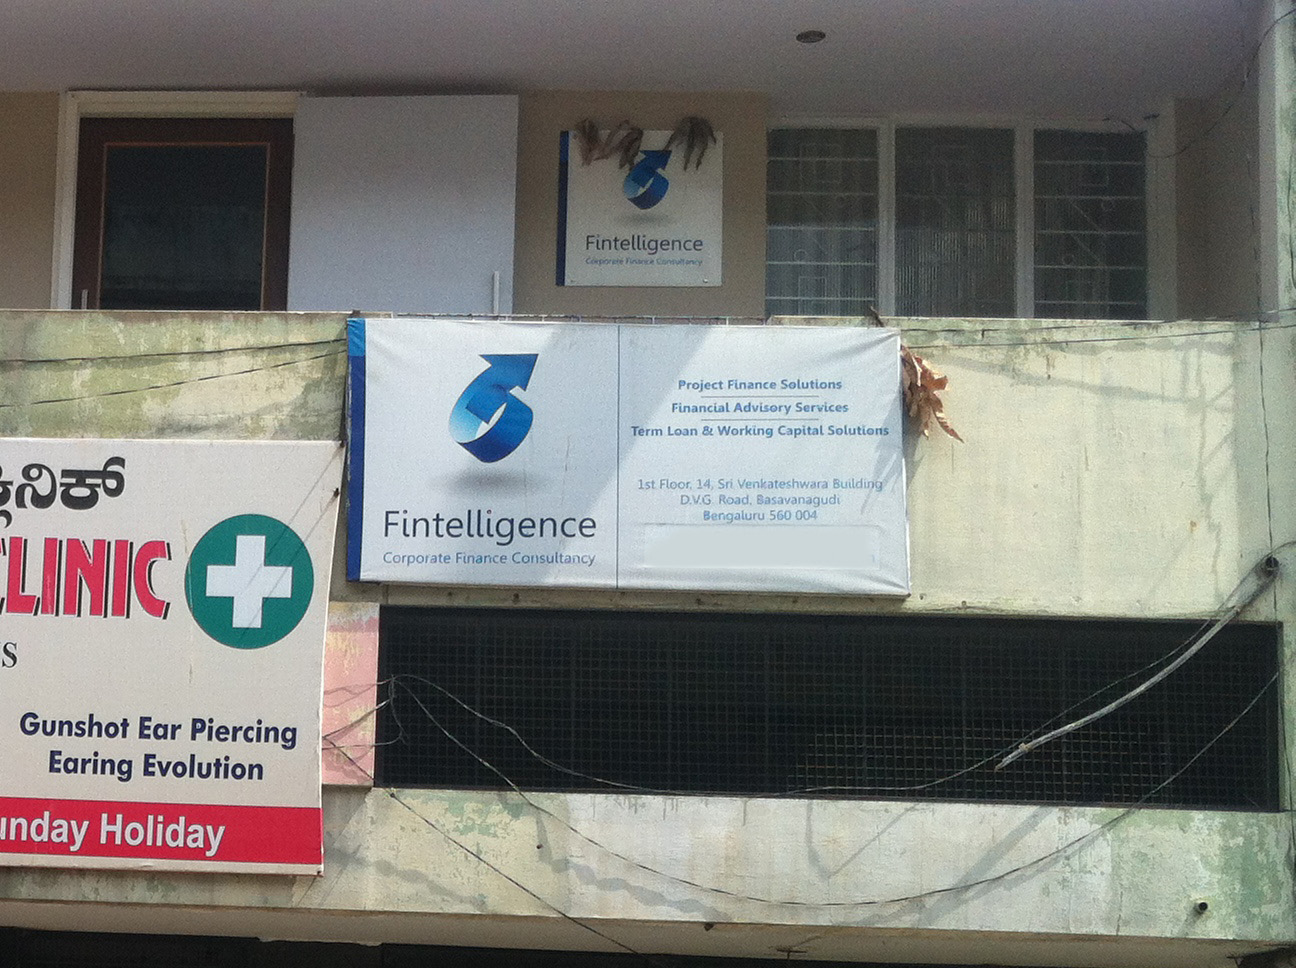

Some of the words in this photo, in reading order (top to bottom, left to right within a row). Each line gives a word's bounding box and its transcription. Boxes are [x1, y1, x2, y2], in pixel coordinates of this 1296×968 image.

[585, 234, 704, 255] Fintelligence
[585, 257, 624, 267] Corporate
[625, 257, 654, 266] Finance
[656, 258, 703, 267] Consultancy
[678, 380, 723, 392] Project
[727, 379, 777, 390] Finance
[780, 379, 842, 390] Solutions
[672, 402, 729, 413] Financial
[733, 402, 791, 415] Advisory
[795, 402, 848, 413] Services
[631, 426, 663, 437] Term
[667, 426, 698, 437] Loan
[702, 426, 714, 437] &
[717, 425, 774, 438] Working
[777, 425, 824, 438] Capital
[827, 425, 889, 437] Solutions
[638, 479, 655, 490] 1st
[718, 478, 733, 489] Sri
[737, 478, 829, 490] Venkateshwara
[833, 478, 883, 491] Building
[756, 494, 841, 507] Basavanagudi
[703, 510, 765, 523] Bengaluru
[769, 510, 792, 521] 560
[795, 510, 818, 521] 004
[383, 509, 597, 546] Fintelligence
[382, 551, 452, 566] Corporate
[455, 552, 508, 565] Finance
[511, 552, 596, 567] Consultancy
[19, 712, 130, 740] Gunshot
[139, 716, 182, 741] Ear
[190, 718, 298, 750] Piercing
[49, 750, 133, 782] Earing
[143, 754, 264, 780] Evolution
[99, 813, 226, 857] Holiday
